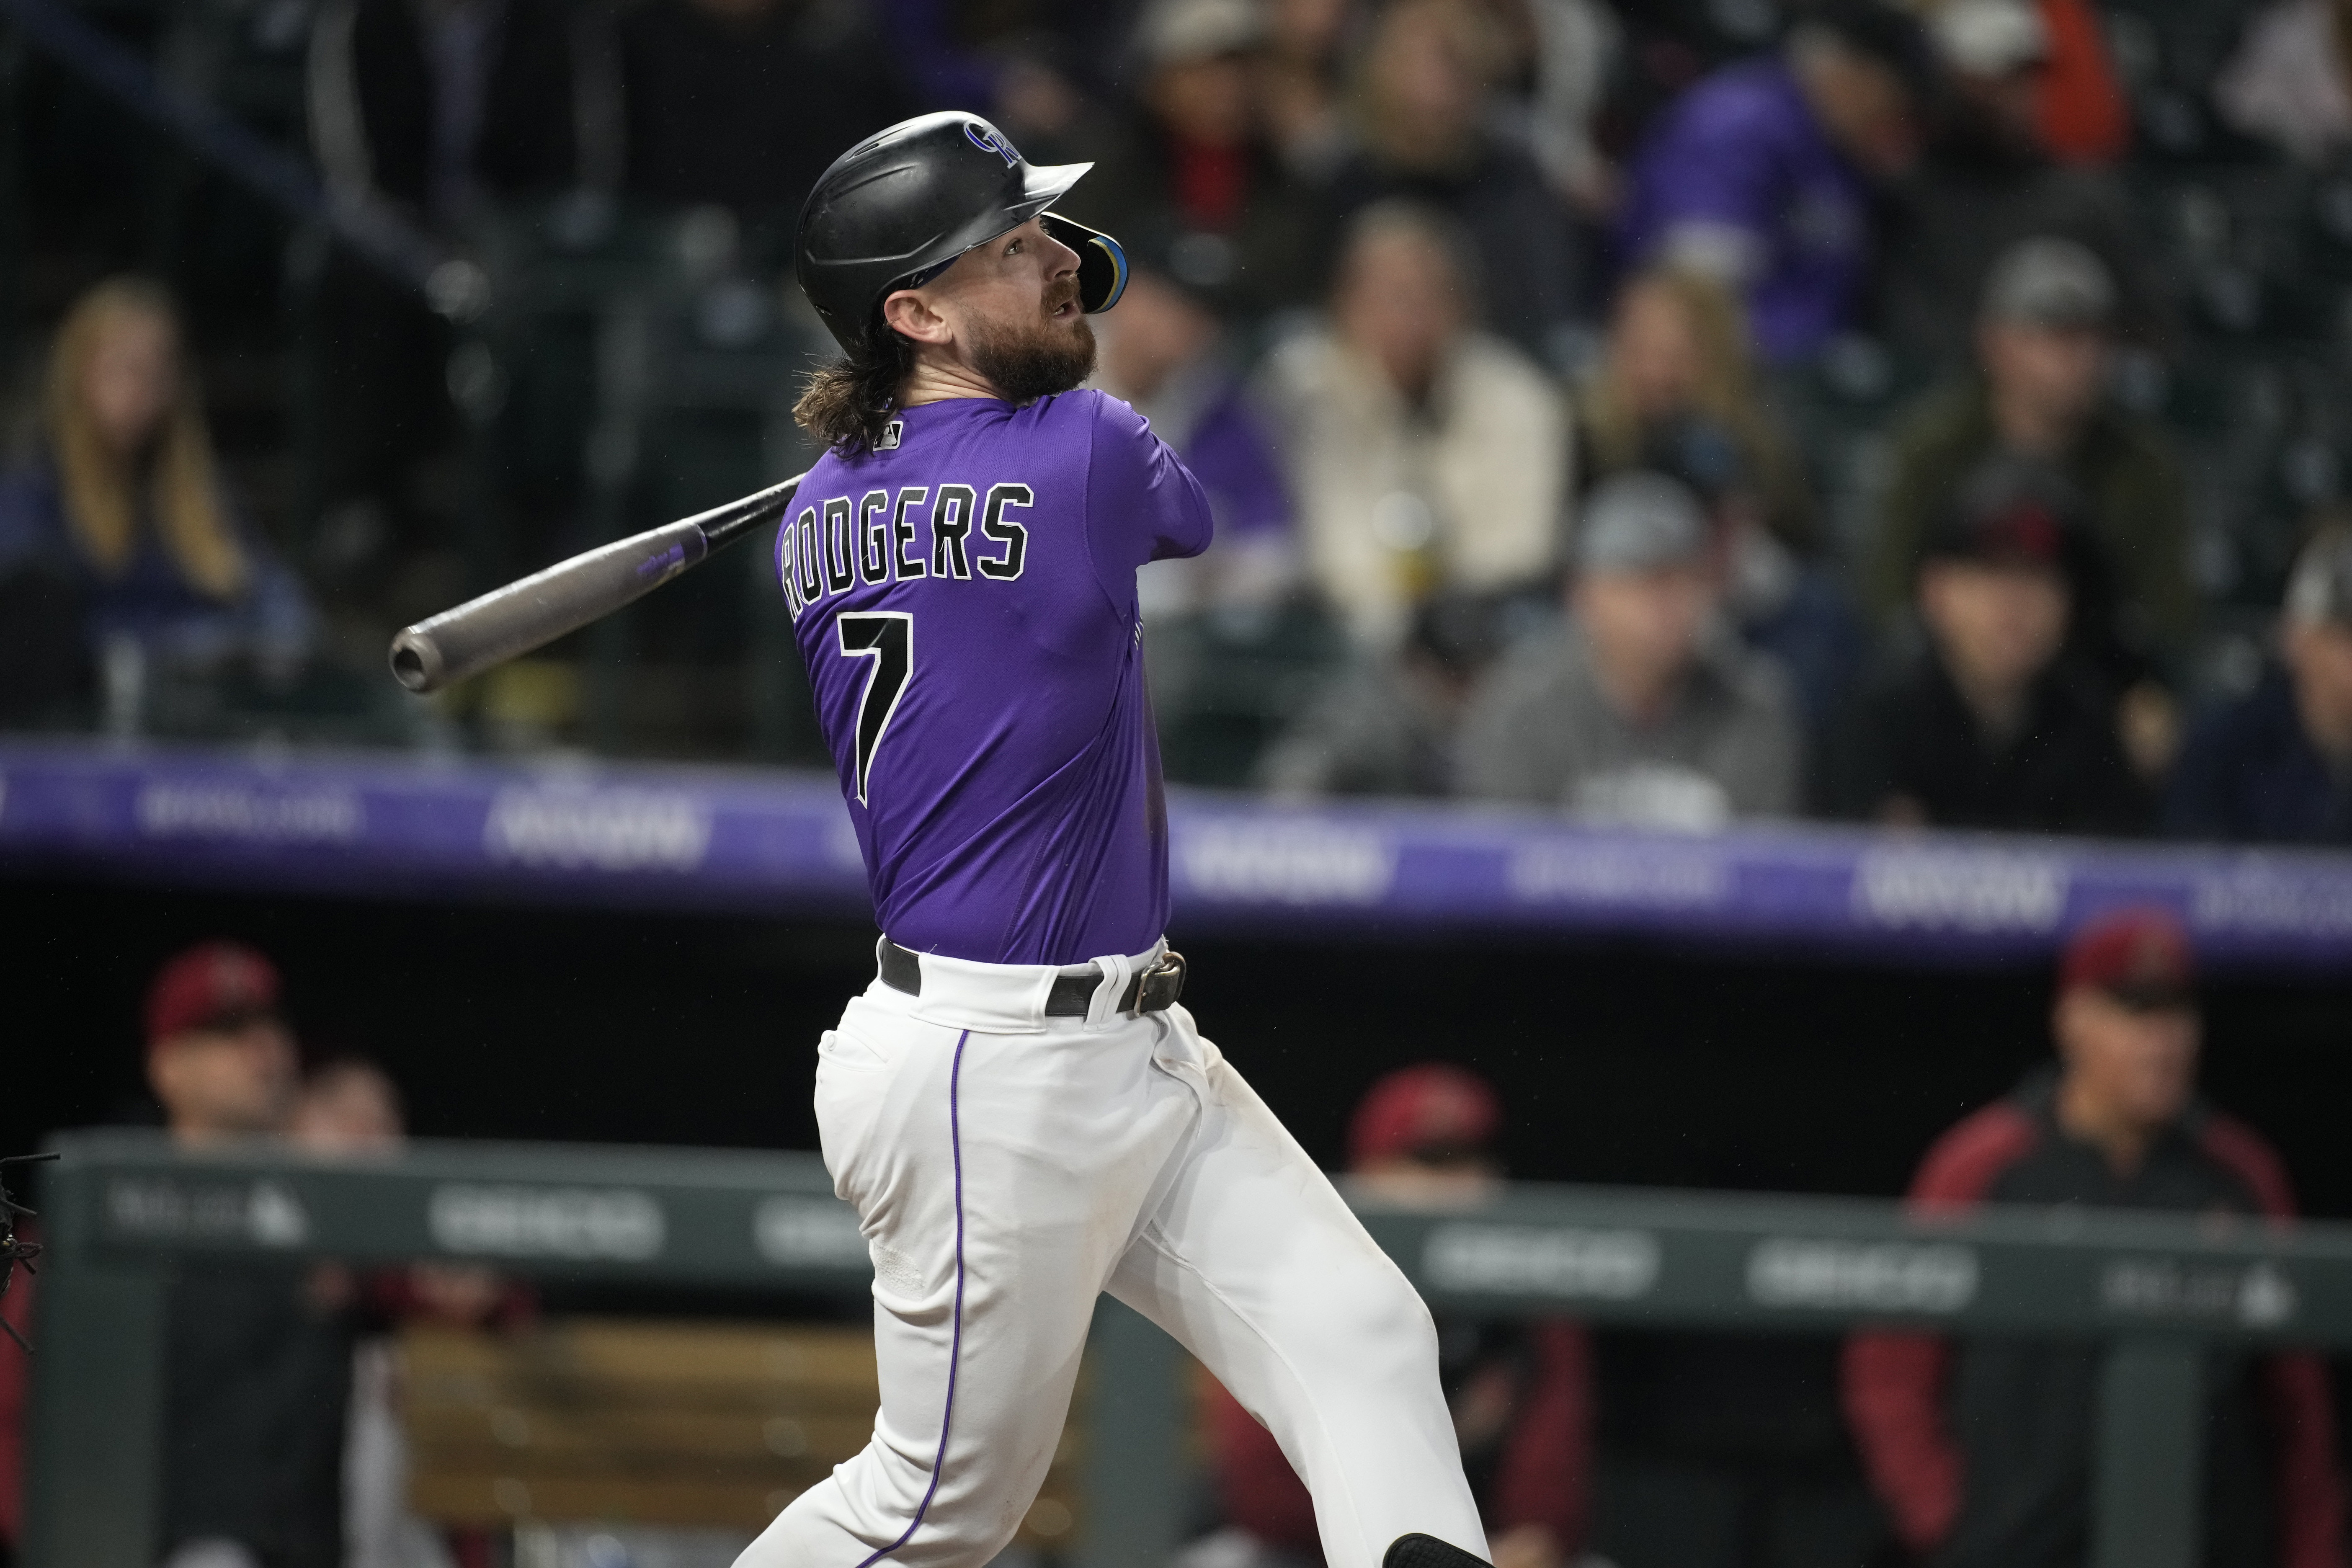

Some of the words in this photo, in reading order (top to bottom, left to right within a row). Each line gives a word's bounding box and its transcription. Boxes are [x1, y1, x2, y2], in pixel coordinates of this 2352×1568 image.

[963, 119, 1022, 169] CR
[781, 483, 1034, 623] RODGERS
[836, 611, 913, 809] 7
